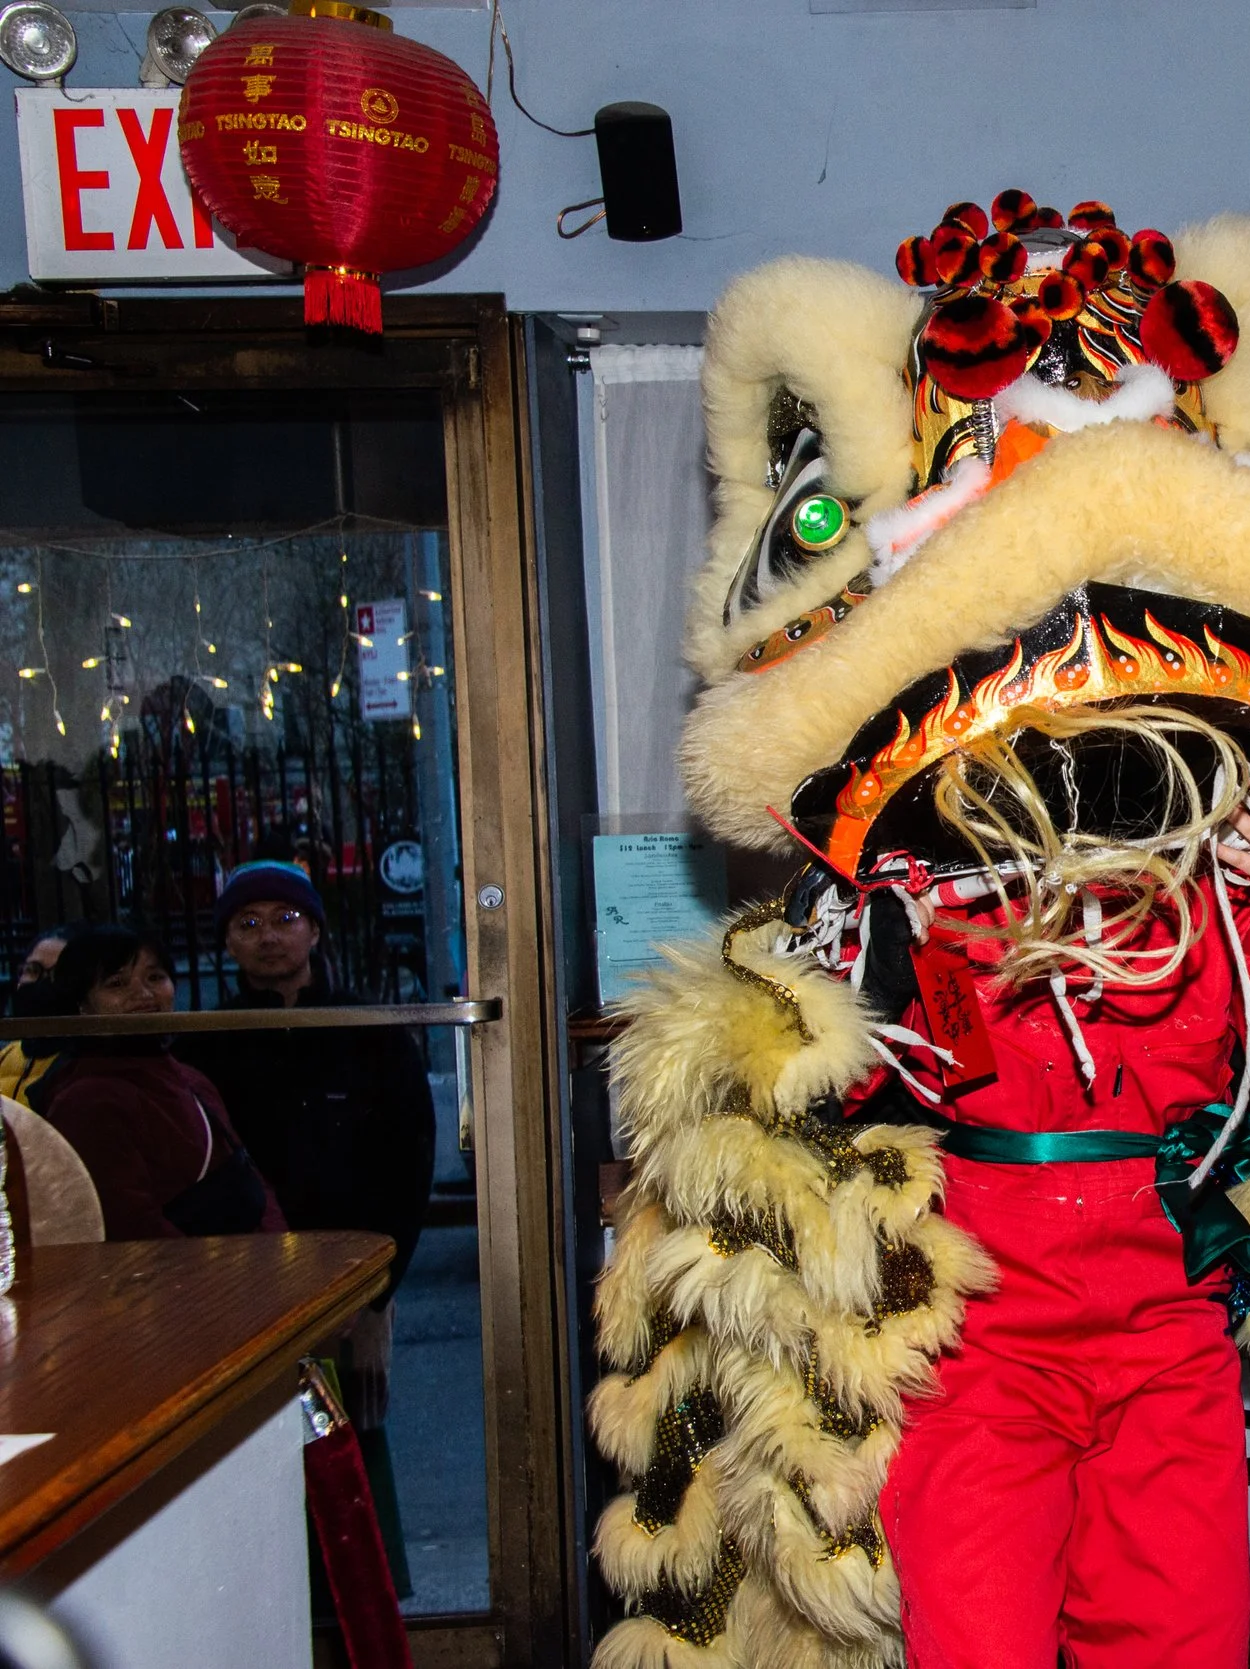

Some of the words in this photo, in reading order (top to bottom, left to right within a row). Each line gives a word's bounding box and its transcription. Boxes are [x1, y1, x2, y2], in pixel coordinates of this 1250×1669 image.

[215, 112, 307, 132] TSINGTAO
[326, 119, 430, 154] TSINGTAO
[53, 108, 249, 251] EX
